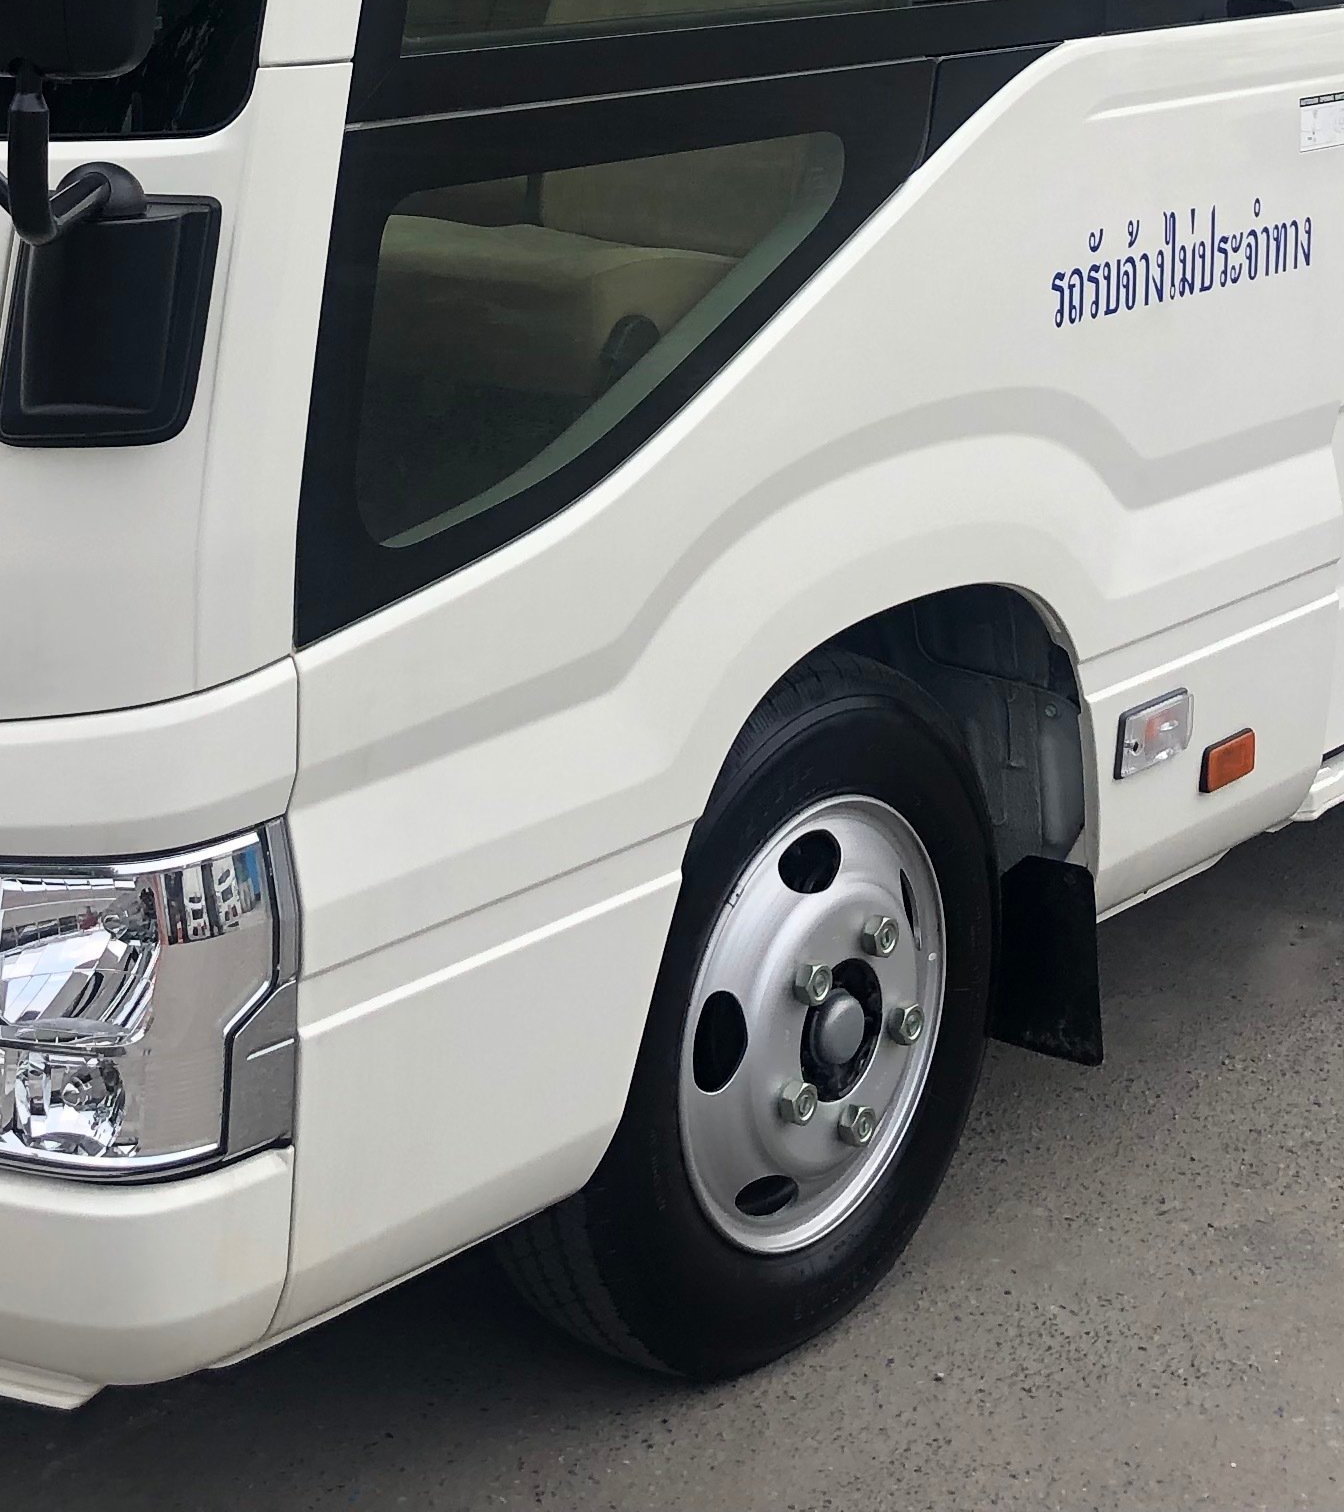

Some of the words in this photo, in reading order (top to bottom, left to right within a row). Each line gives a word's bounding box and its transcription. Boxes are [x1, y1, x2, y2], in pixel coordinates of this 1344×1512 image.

[1050, 197, 1313, 329] รถรับจ้างไม่ประจำทาง
